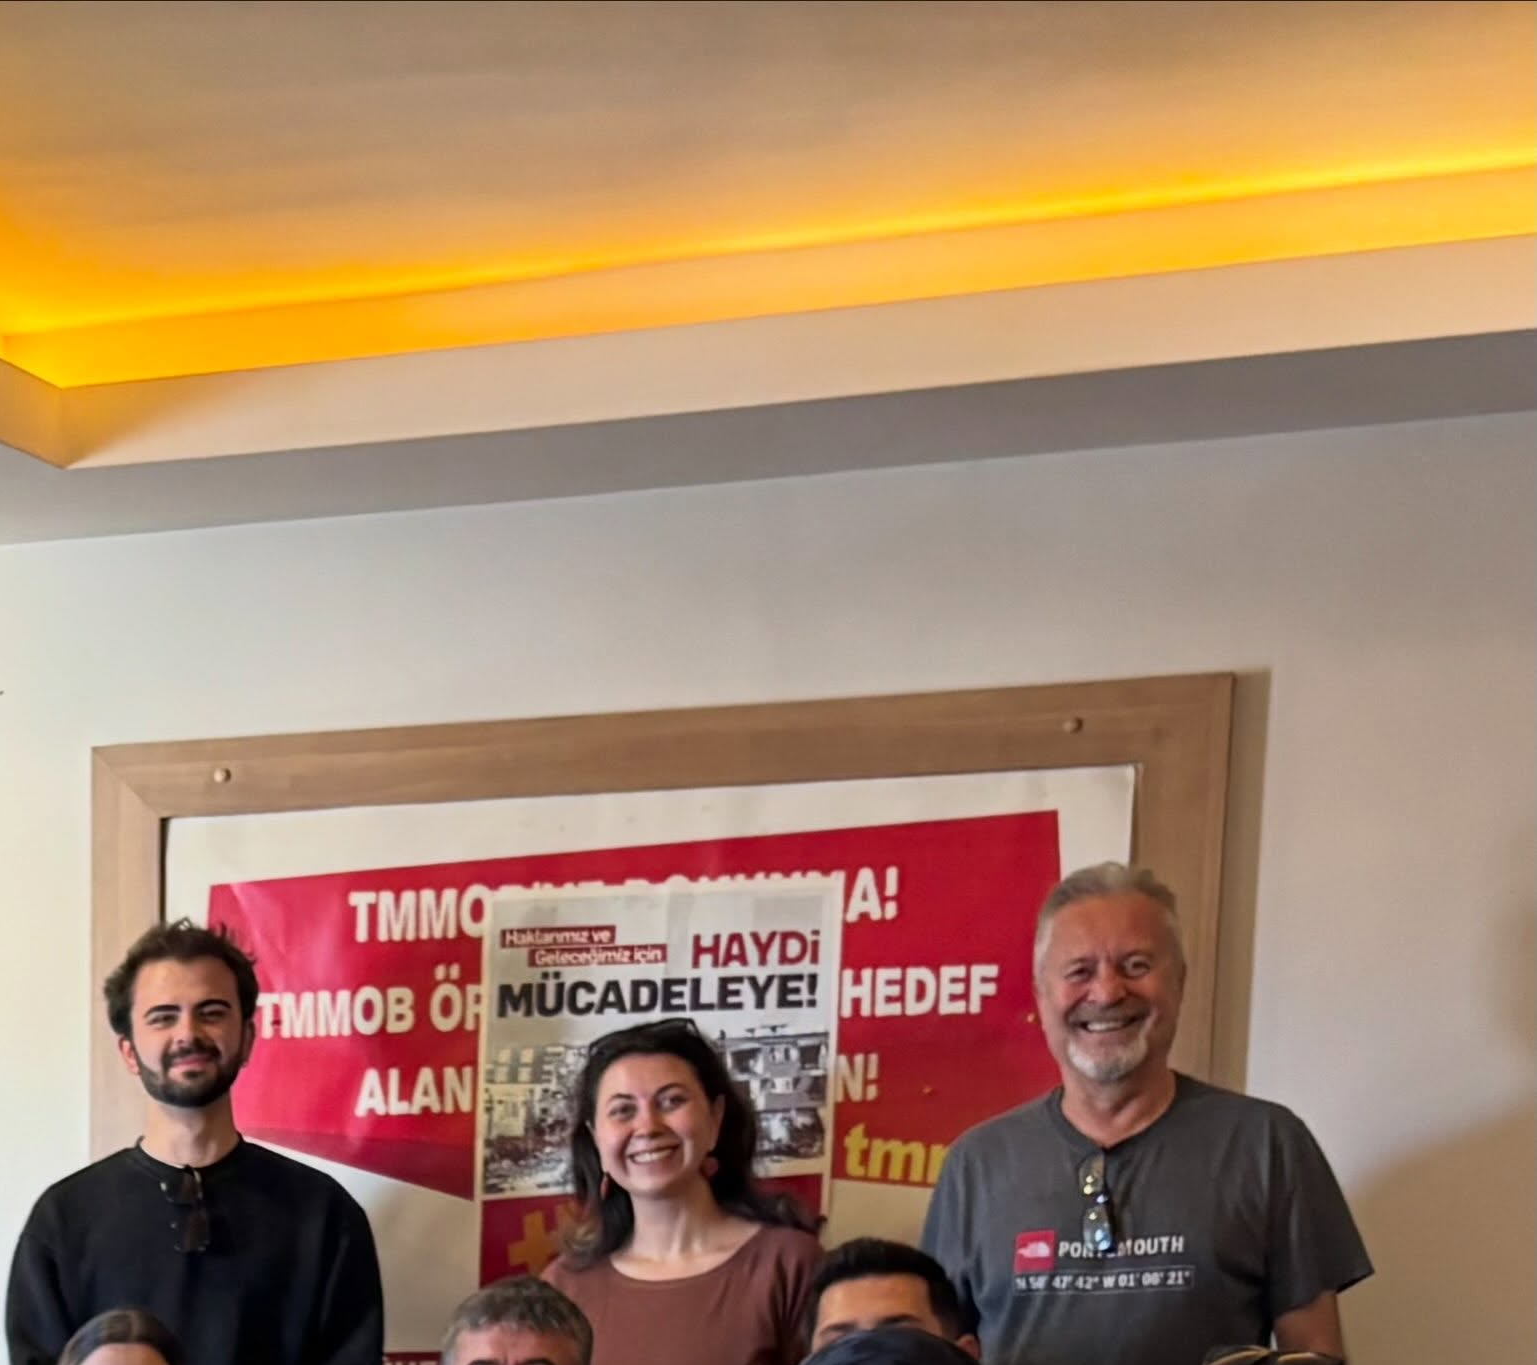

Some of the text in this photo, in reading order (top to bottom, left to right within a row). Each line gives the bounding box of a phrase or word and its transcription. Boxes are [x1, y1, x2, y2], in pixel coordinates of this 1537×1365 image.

[591, 930, 612, 943] ve
[257, 985, 415, 1040] TMMOB
[841, 964, 999, 1018] HEDEF
[497, 971, 818, 1018] MÜCADELEYE!
[1103, 1275, 1116, 1288] W
